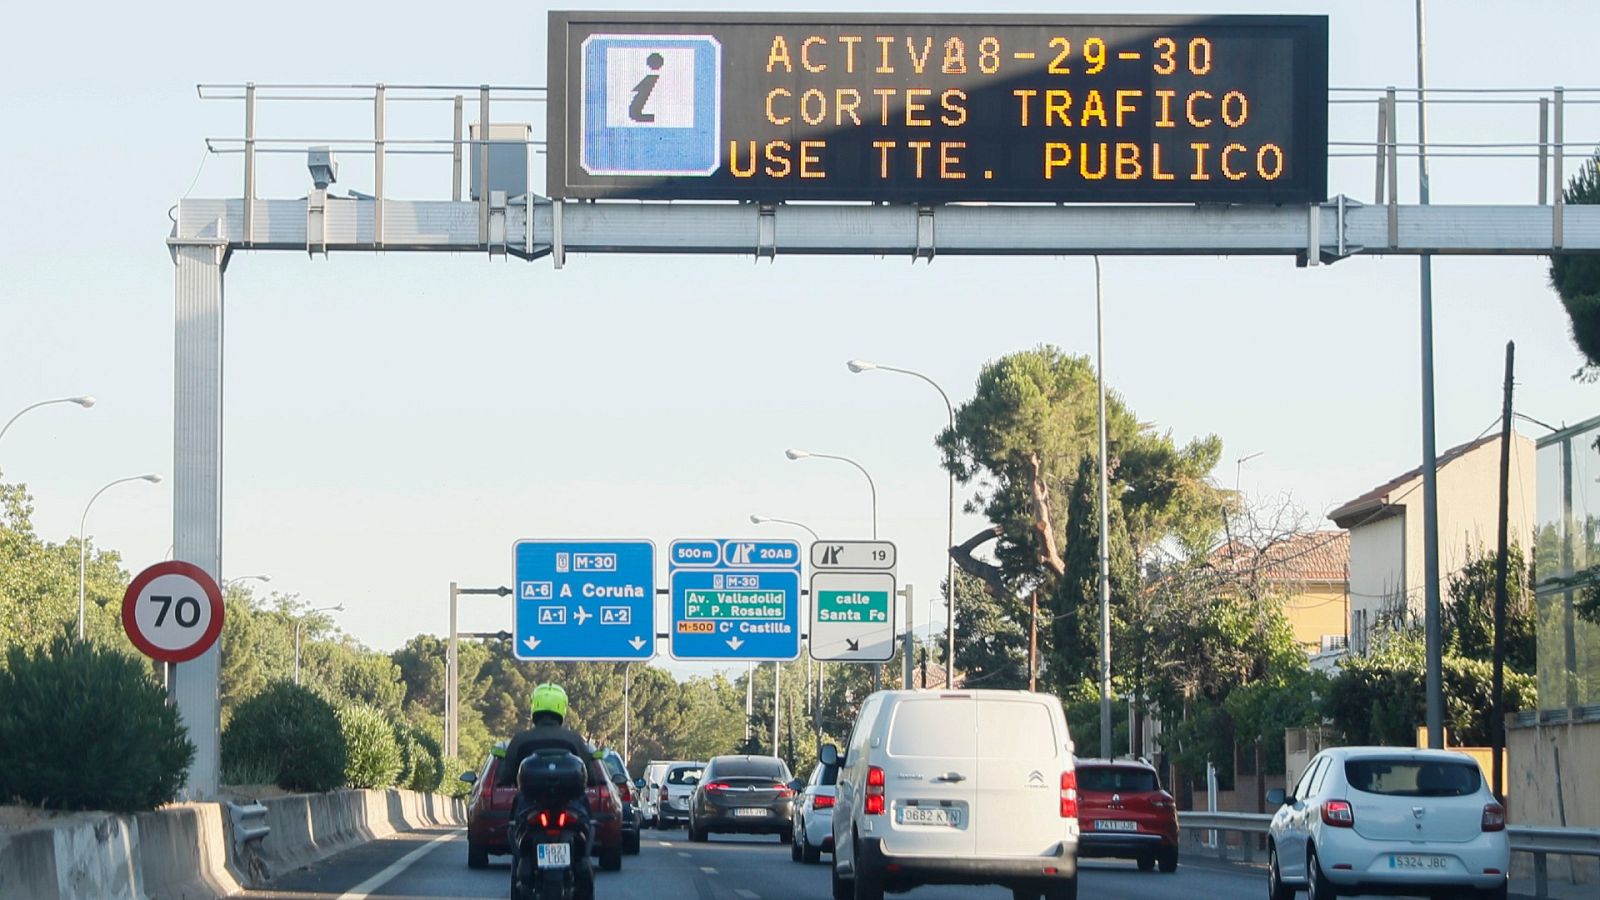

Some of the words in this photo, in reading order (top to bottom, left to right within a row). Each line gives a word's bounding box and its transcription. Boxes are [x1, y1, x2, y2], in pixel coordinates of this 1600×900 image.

[765, 88, 967, 127] CORTES
[1013, 89, 1249, 128] TRAFICO
[730, 140, 827, 178] USE
[872, 141, 995, 179] TTE.
[1045, 142, 1284, 181] PUBLICO
[760, 549, 792, 559] 20AB
[872, 550, 886, 561] 19
[576, 556, 613, 568] M-30
[728, 577, 757, 586] M-30
[524, 584, 549, 596] A-6
[560, 583, 572, 597] A
[582, 583, 645, 597] Coruña
[688, 592, 710, 604] Av.
[717, 592, 782, 604] Valladolid
[836, 593, 870, 604] calle
[150, 595, 201, 628] 70
[542, 609, 564, 621] A-1
[604, 610, 628, 621] A-2
[711, 605, 724, 617] P.
[731, 605, 782, 617] Rosales
[820, 609, 861, 620] Santa
[869, 609, 886, 621] Fe
[678, 623, 713, 631] M-500
[740, 622, 791, 633] Castilla
[905, 809, 933, 821] 0682
